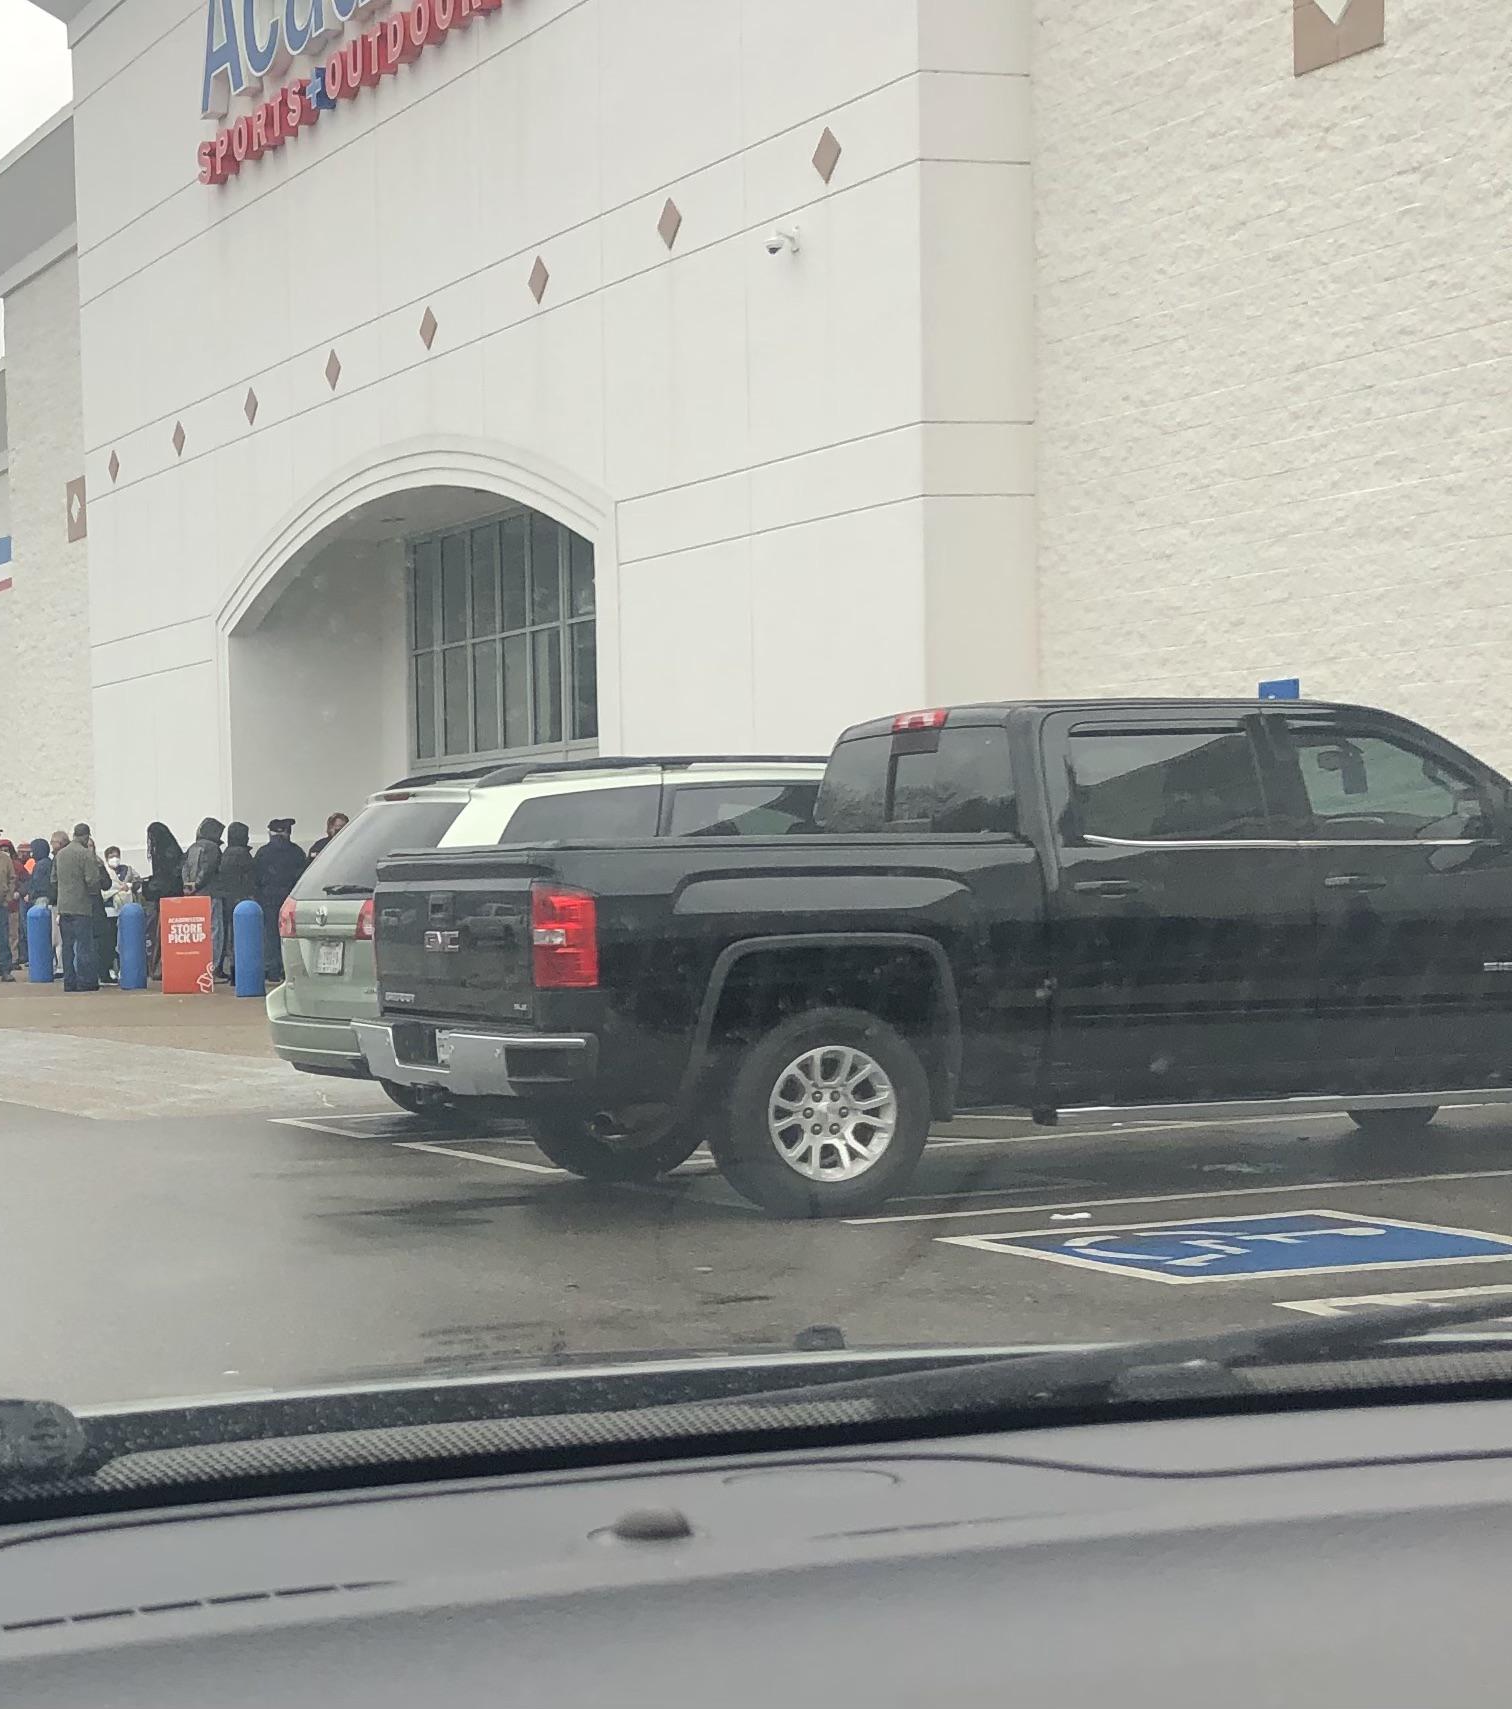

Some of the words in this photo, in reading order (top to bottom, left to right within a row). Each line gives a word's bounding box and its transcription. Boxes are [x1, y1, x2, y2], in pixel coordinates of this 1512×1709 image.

[170, 923, 203, 934] STORE
[168, 933, 191, 944] PICK
[192, 932, 207, 943] UP
